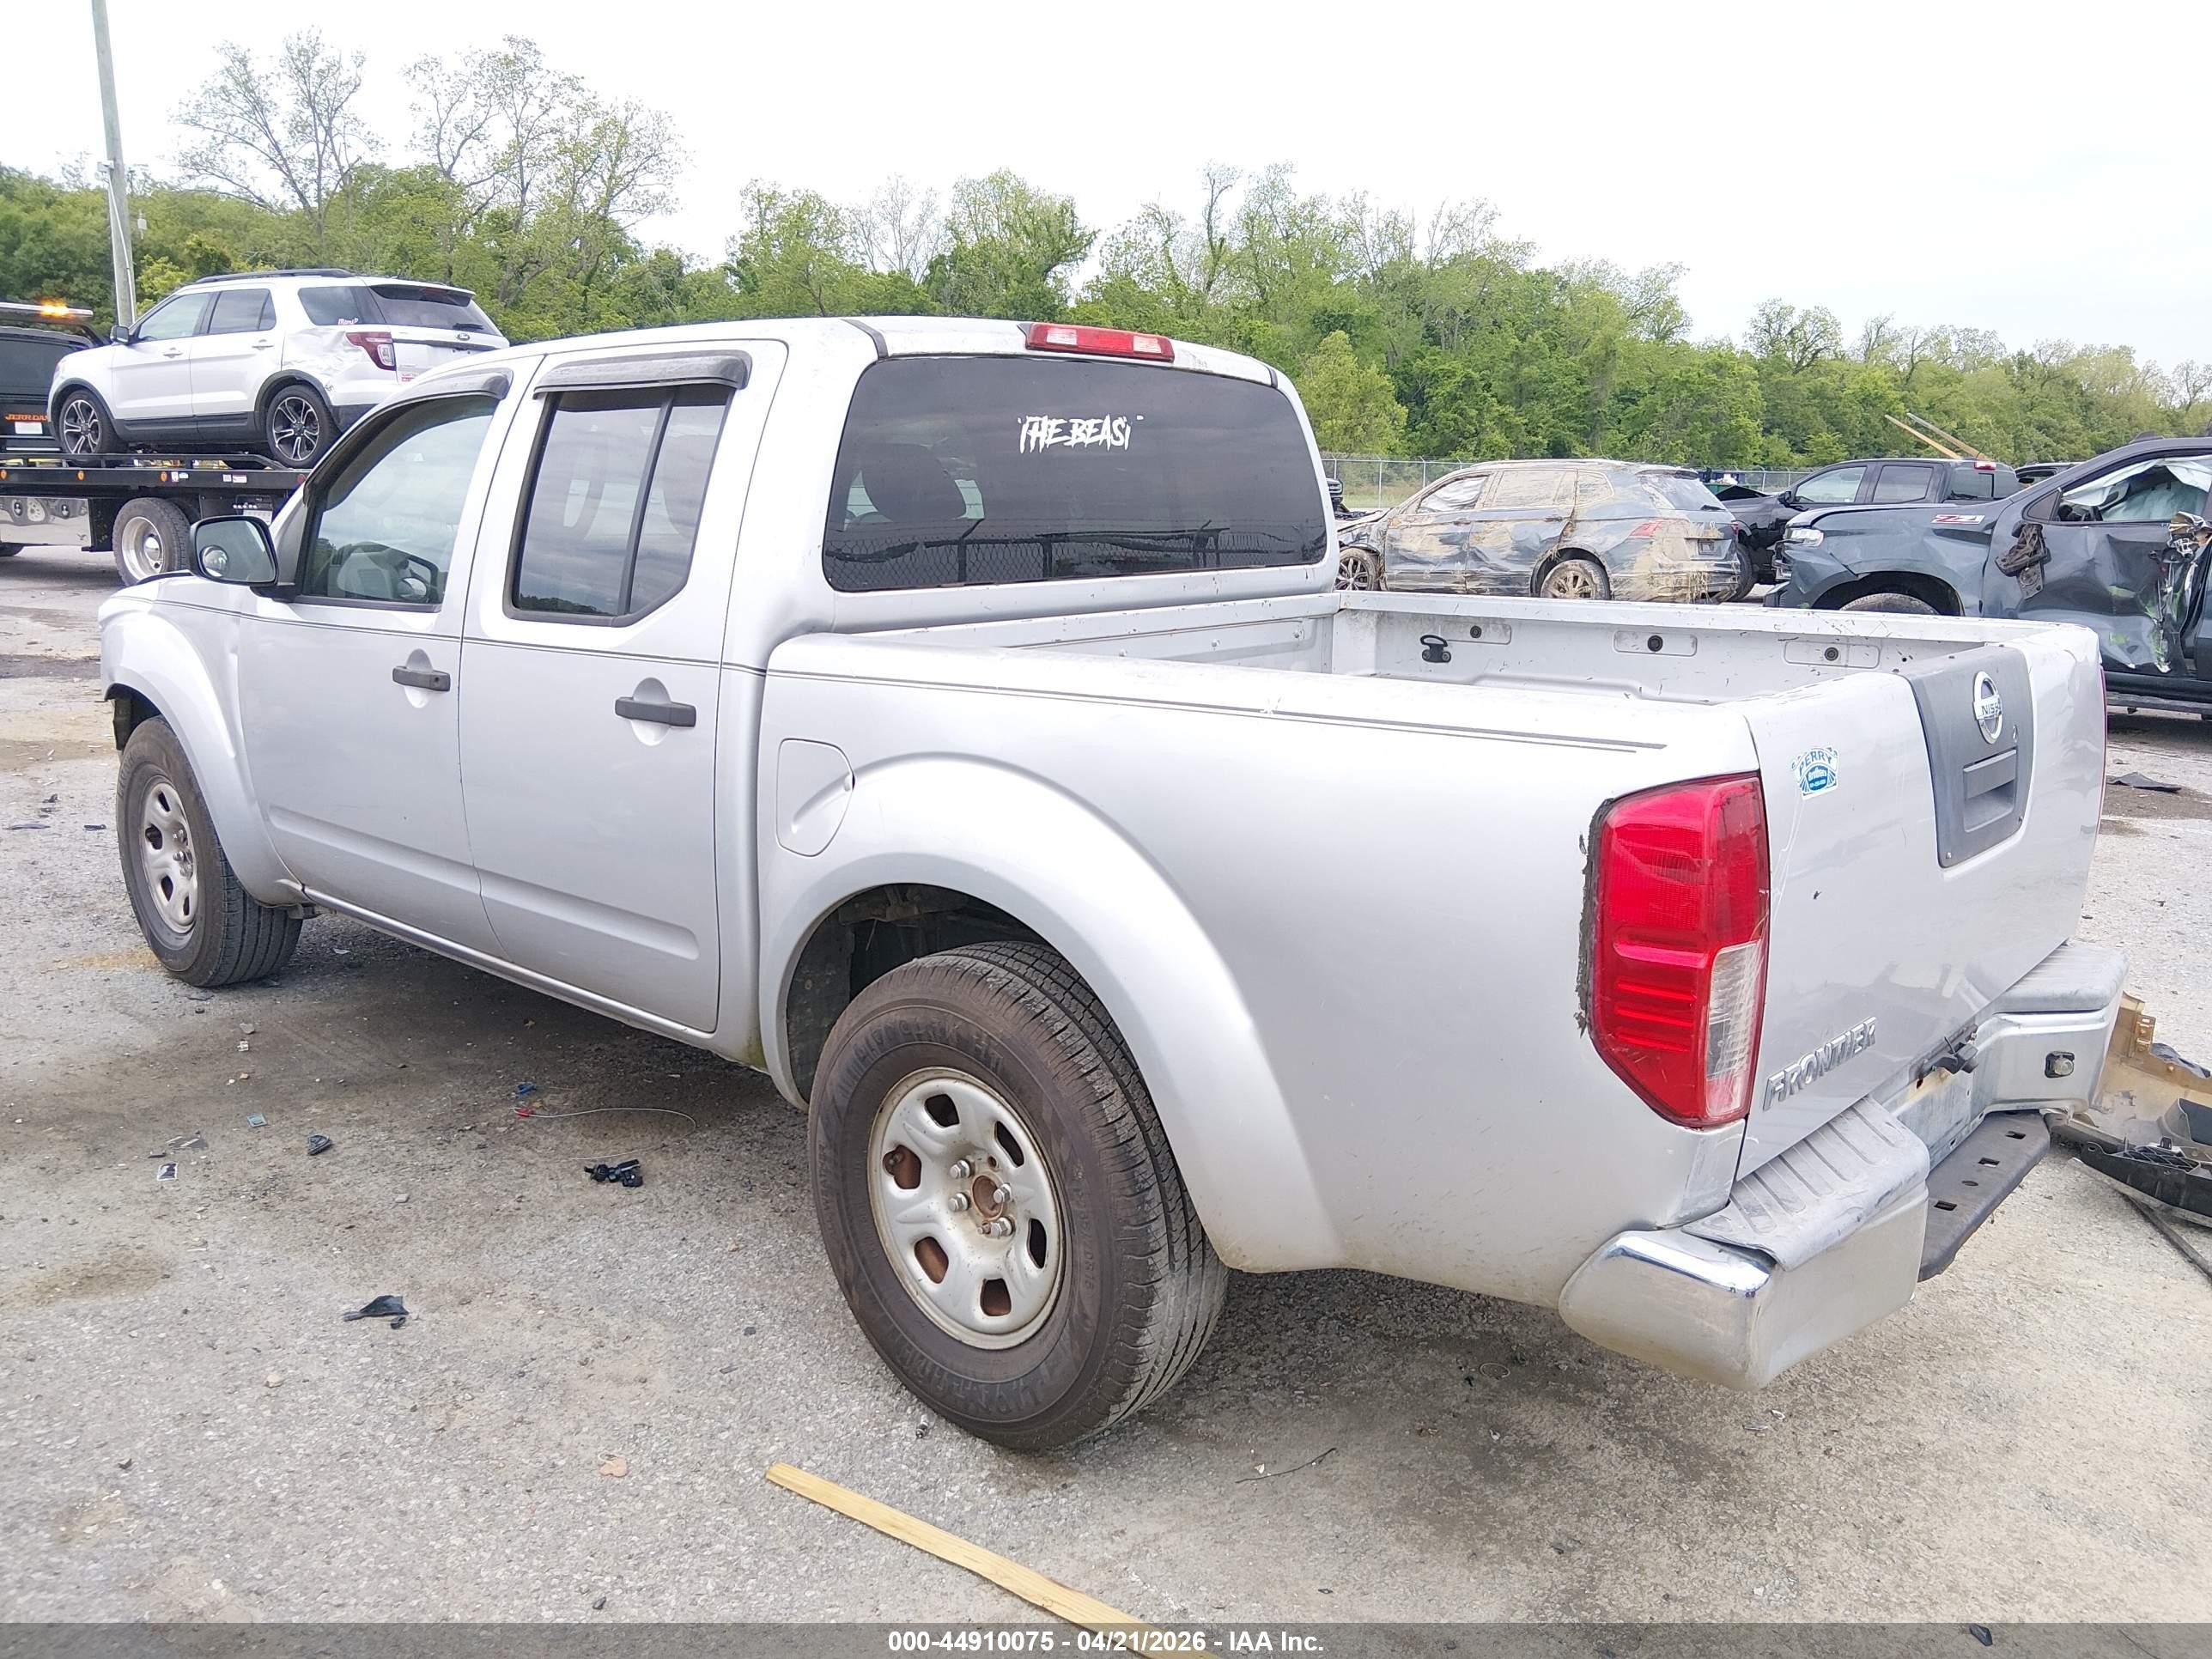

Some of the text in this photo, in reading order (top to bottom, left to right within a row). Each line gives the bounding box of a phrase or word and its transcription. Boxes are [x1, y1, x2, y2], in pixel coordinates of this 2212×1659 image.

[1018, 415, 1071, 453] THE
[1799, 750, 1832, 777] PERRY
[1763, 1016, 1876, 1112] FRONTIER
